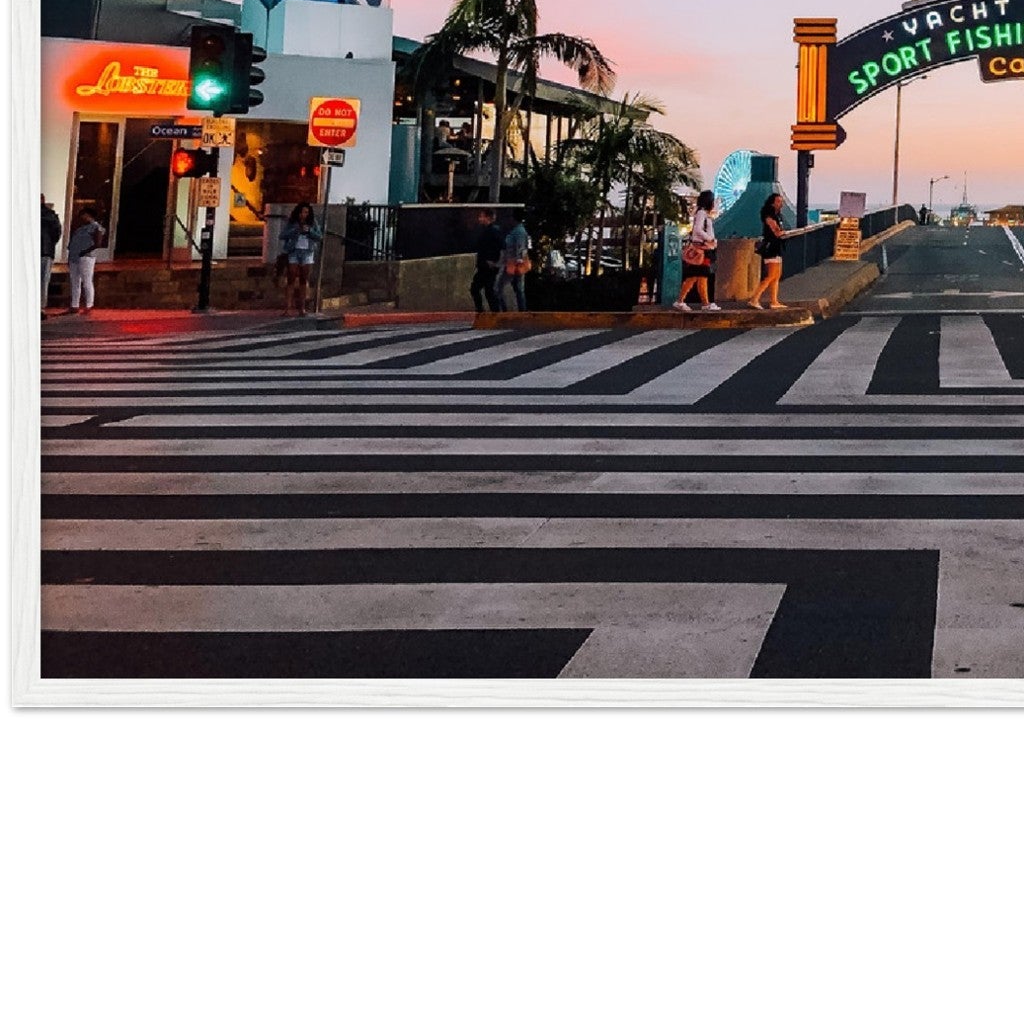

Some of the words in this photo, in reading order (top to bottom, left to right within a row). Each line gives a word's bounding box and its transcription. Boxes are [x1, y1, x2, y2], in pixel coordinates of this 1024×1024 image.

[848, 37, 932, 95] SPORT
[133, 65, 159, 78] THE
[318, 107, 332, 116] DO
[335, 108, 353, 116] NOT
[152, 126, 188, 135] Ocean
[320, 128, 347, 137] ENTER
